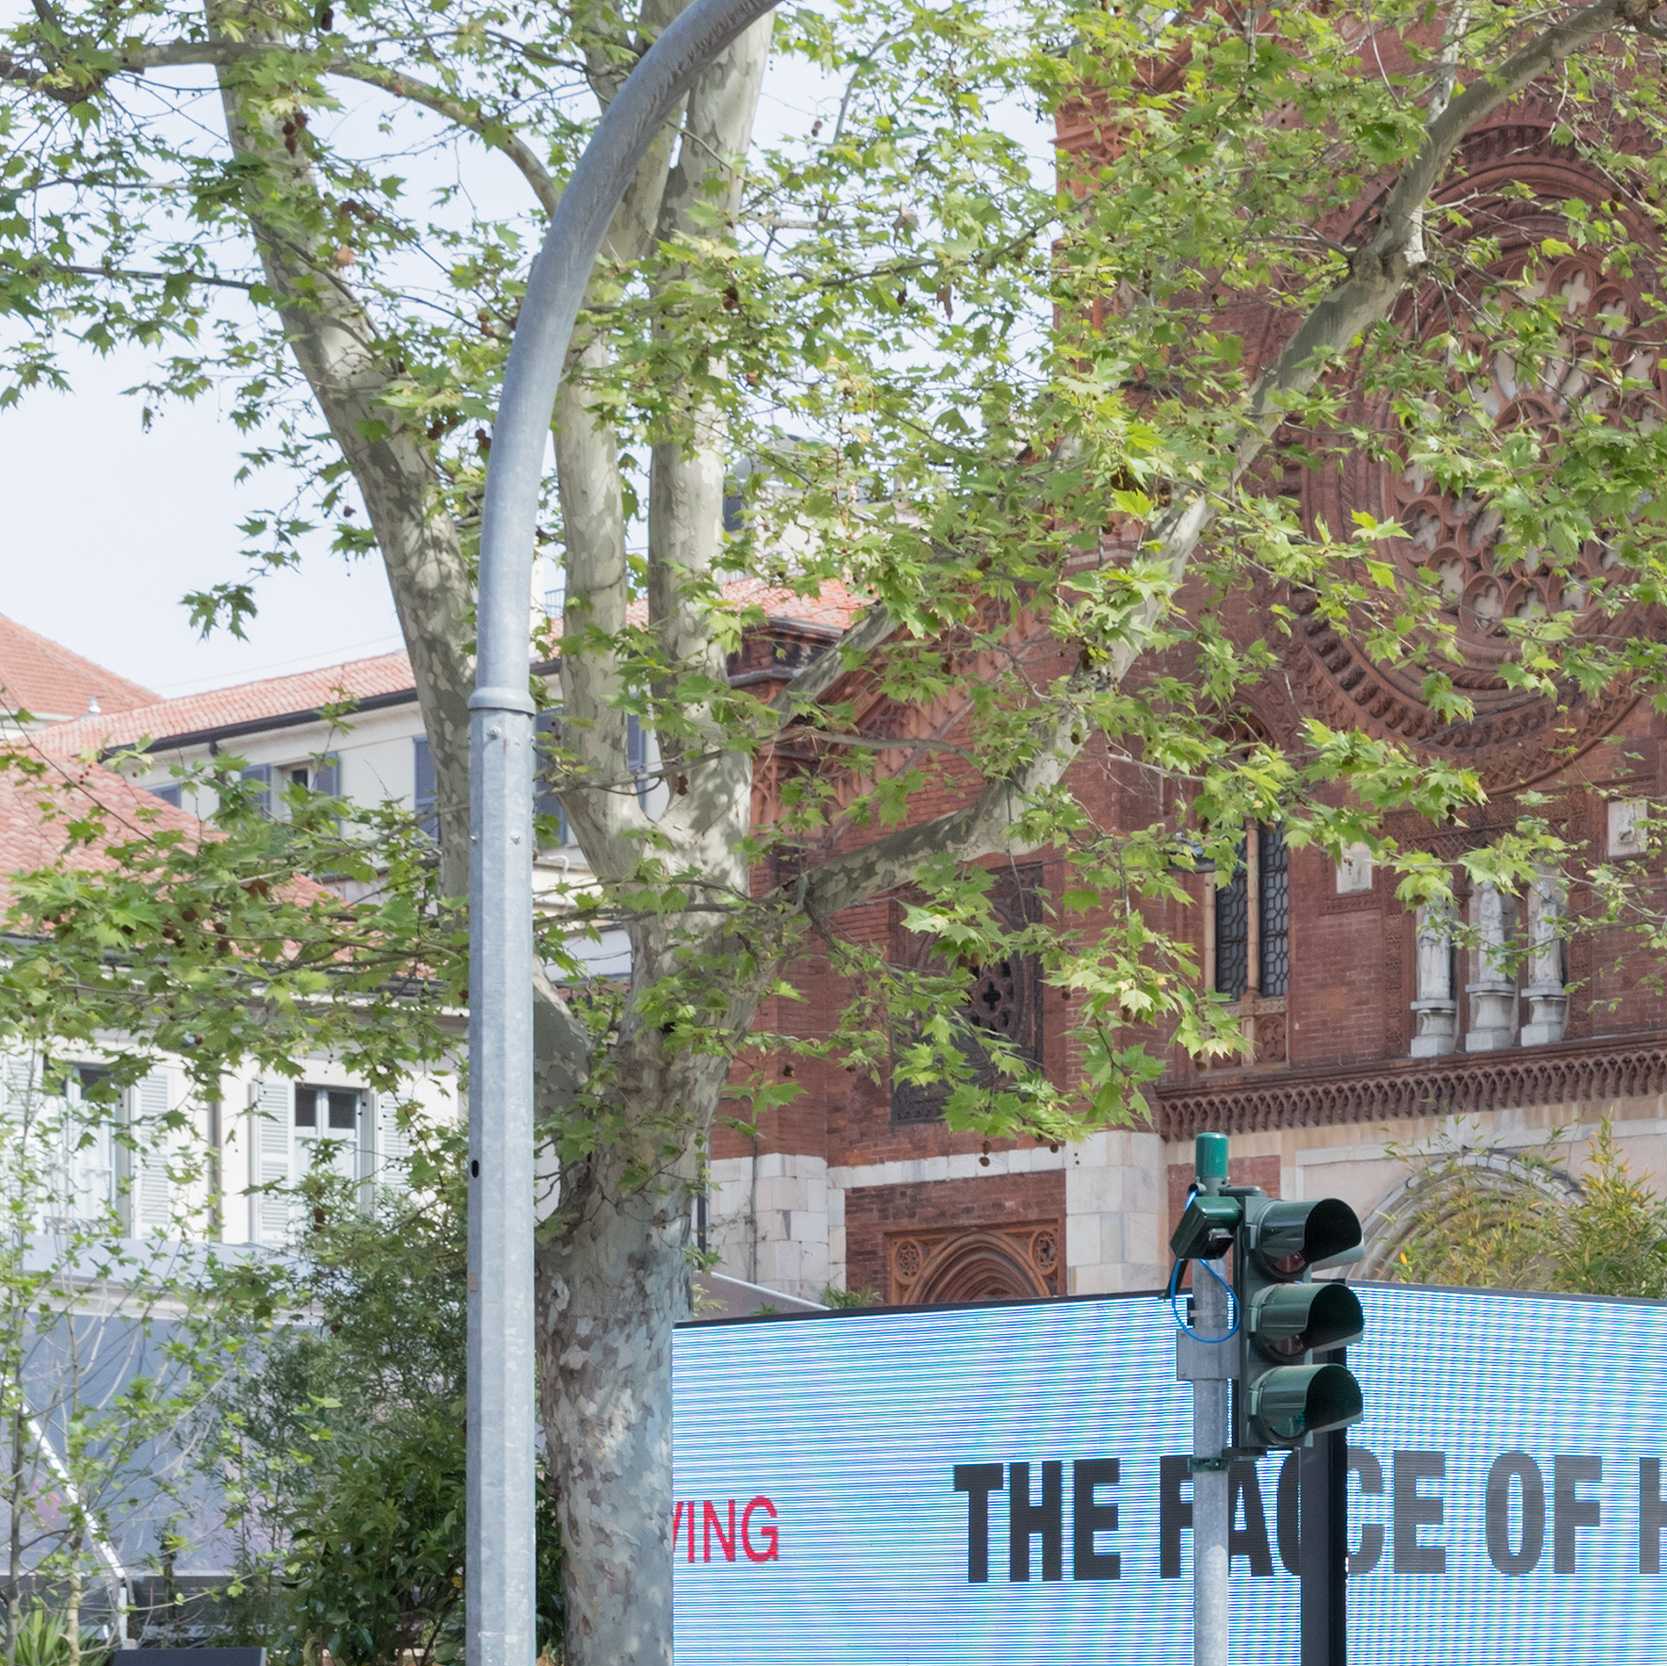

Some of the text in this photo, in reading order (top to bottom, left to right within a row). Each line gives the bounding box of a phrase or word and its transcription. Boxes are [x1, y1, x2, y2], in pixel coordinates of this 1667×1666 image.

[953, 1457, 1121, 1583] THE
[1160, 1448, 1446, 1579] FACE
[1486, 1450, 1602, 1576] OF
